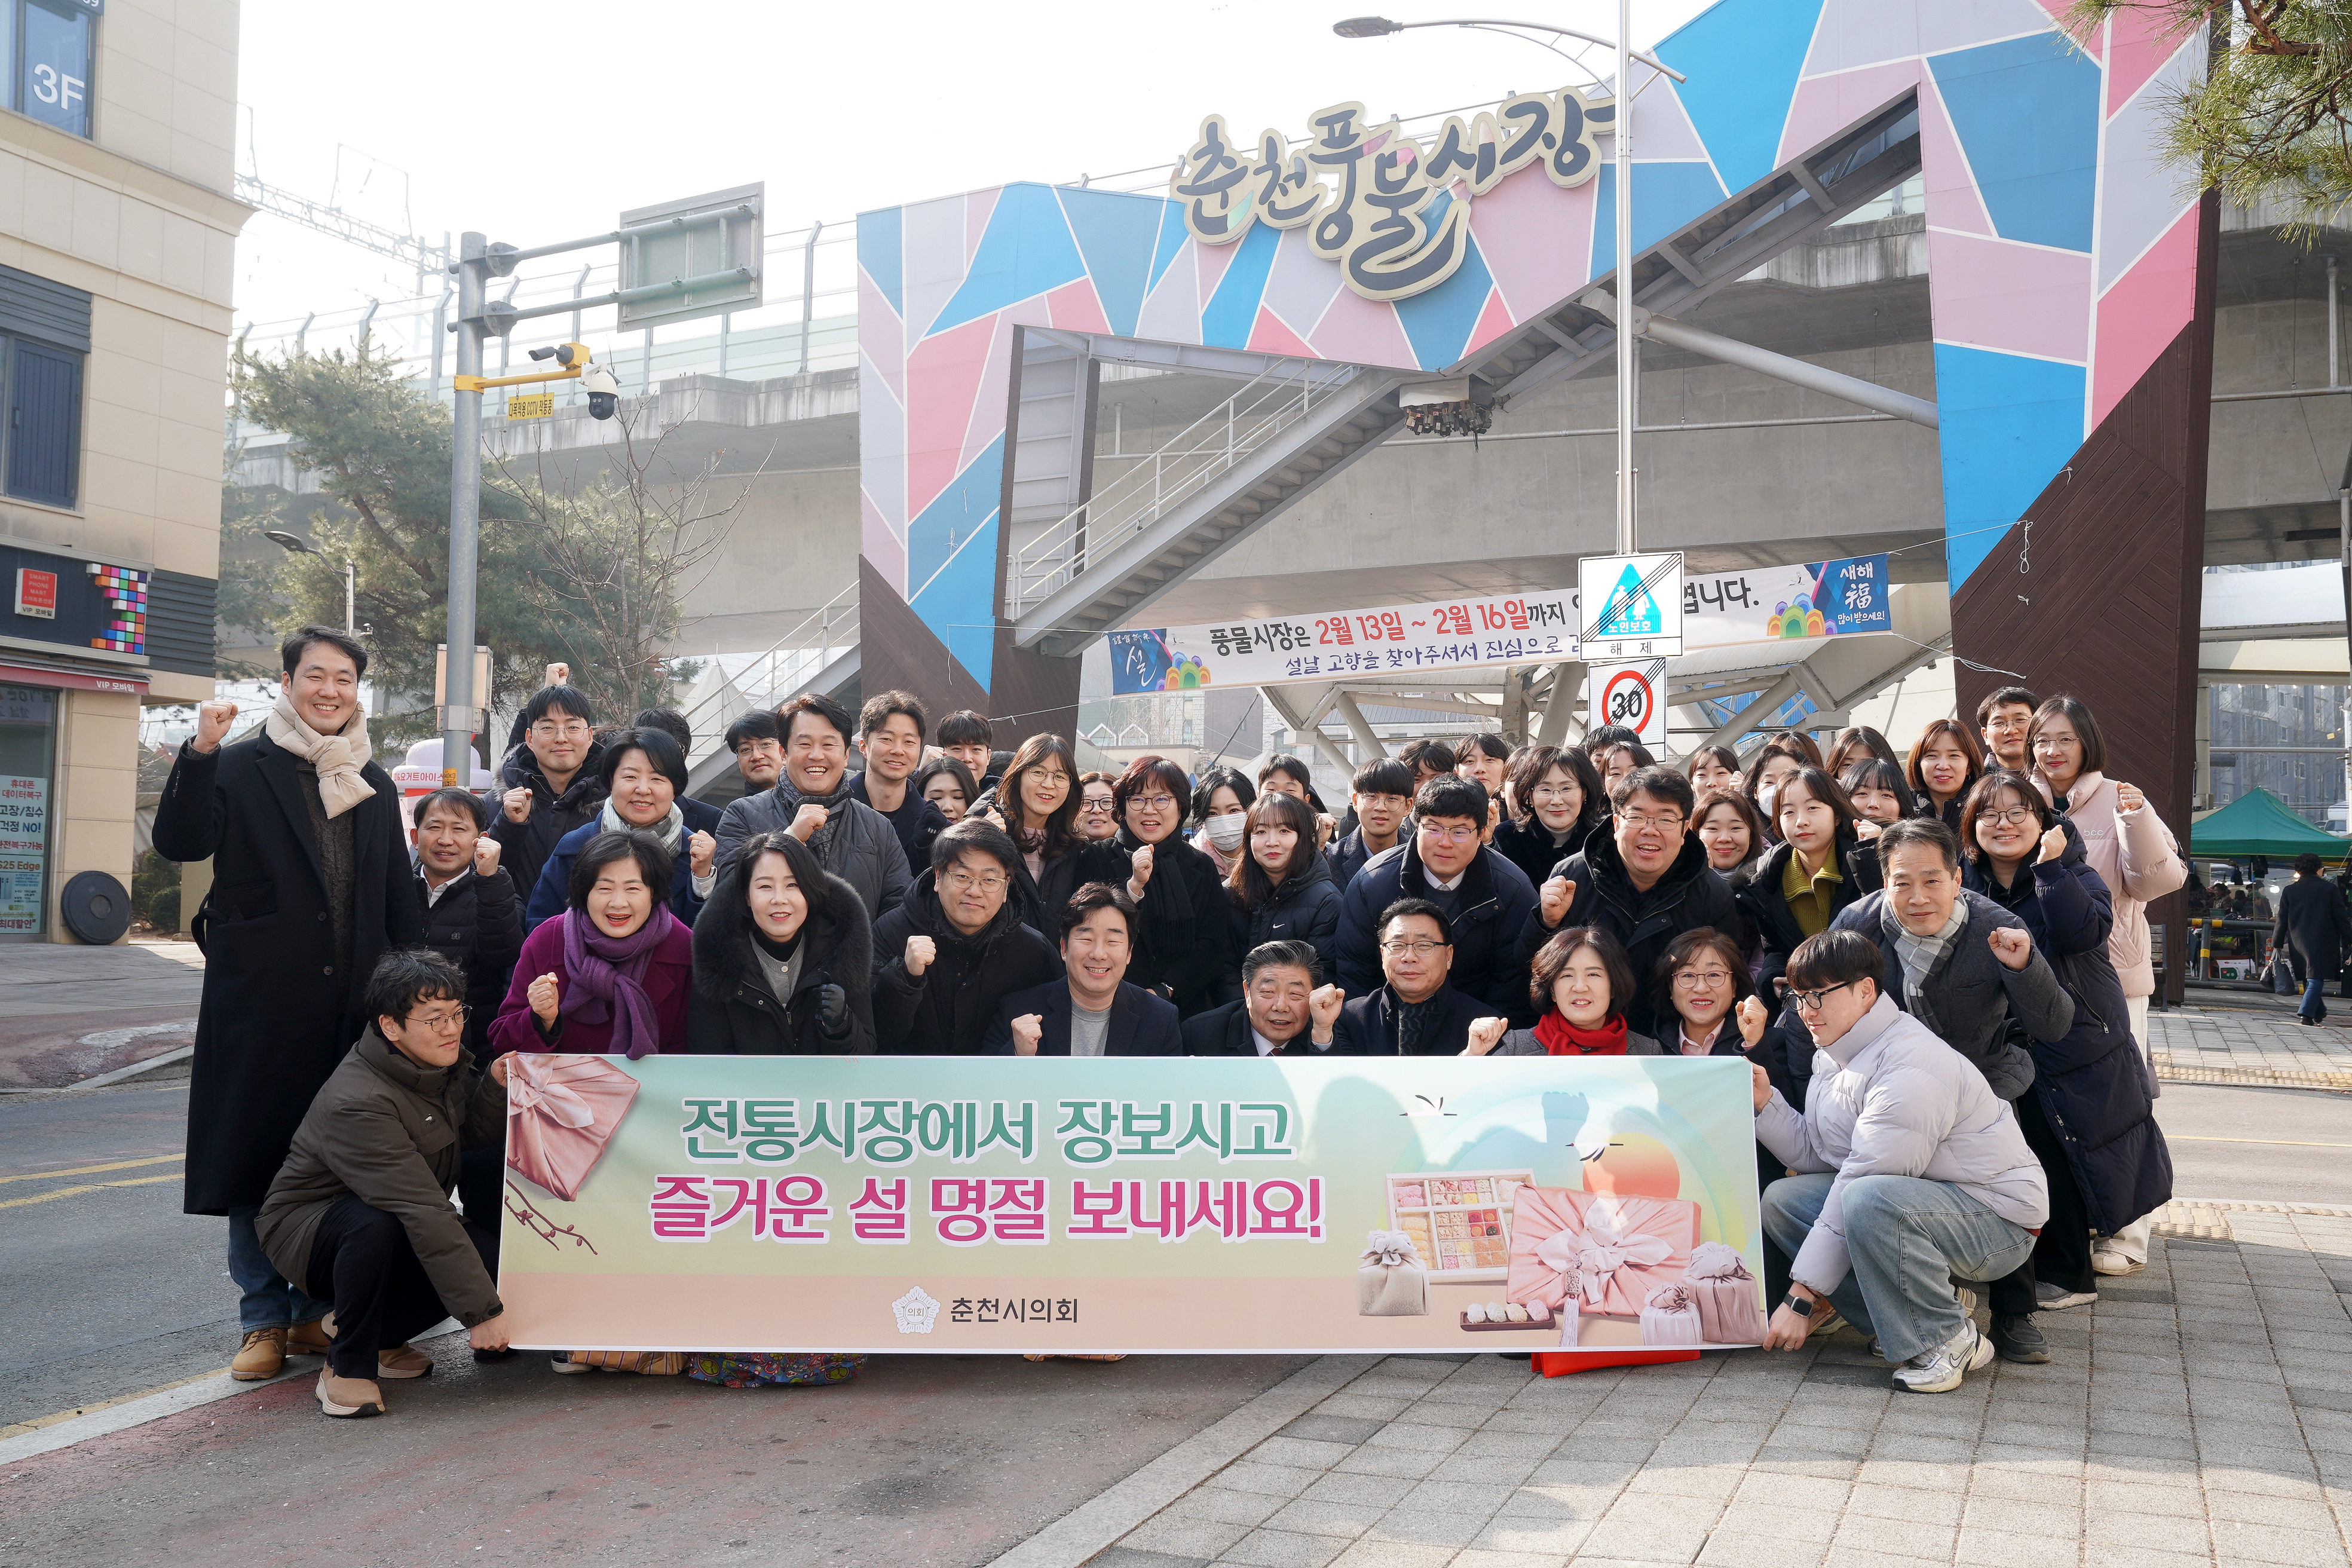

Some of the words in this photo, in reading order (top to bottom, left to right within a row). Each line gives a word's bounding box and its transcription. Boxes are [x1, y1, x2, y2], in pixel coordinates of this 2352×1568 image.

[33, 63, 85, 110] 3F
[1176, 94, 1616, 291] 춘천풍물시장
[509, 402, 526, 418] 다목적용
[526, 401, 538, 416] CCTV
[539, 399, 552, 415] 작동중
[1840, 562, 1873, 580] 새해
[28, 580, 49, 589] PHONE
[1845, 583, 1872, 610] 福
[35, 608, 53, 617] 모바일
[1838, 612, 1853, 625] 많이
[1854, 610, 1885, 623] 받으세요!
[1209, 622, 1311, 656] 풍물시장은
[1315, 616, 1354, 645] 2월
[1356, 611, 1406, 641] 13일
[1433, 605, 1474, 635] 2월
[1477, 599, 1566, 630] 16일까지
[1608, 620, 1652, 633] 노인보호
[1286, 656, 1320, 676] 설날
[1328, 650, 1379, 671] 고향을
[1386, 641, 1478, 667] 찾아주셔서
[1485, 635, 1563, 659] 진심으로
[1126, 645, 1157, 687] 설
[96, 680, 110, 688] VIP
[112, 682, 134, 693] 모바일
[1612, 691, 1642, 718] 30
[10, 779, 35, 789] 휴대폰
[2, 789, 42, 800] 데이터복구
[0, 805, 44, 817] 고장/침수
[0, 820, 19, 832] 걱정
[23, 822, 41, 833] NO!
[17, 861, 40, 871] Edge
[682, 1100, 1033, 1163] 전통시장에서
[1056, 1101, 1292, 1163] 장보시고
[650, 1175, 829, 1240] 즐거운
[850, 1178, 905, 1239] 설
[931, 1178, 1045, 1242] 명절
[1068, 1178, 1321, 1239] 보내세요!
[907, 1307, 924, 1318] 의회
[951, 1297, 1077, 1323] 춘천시의회
